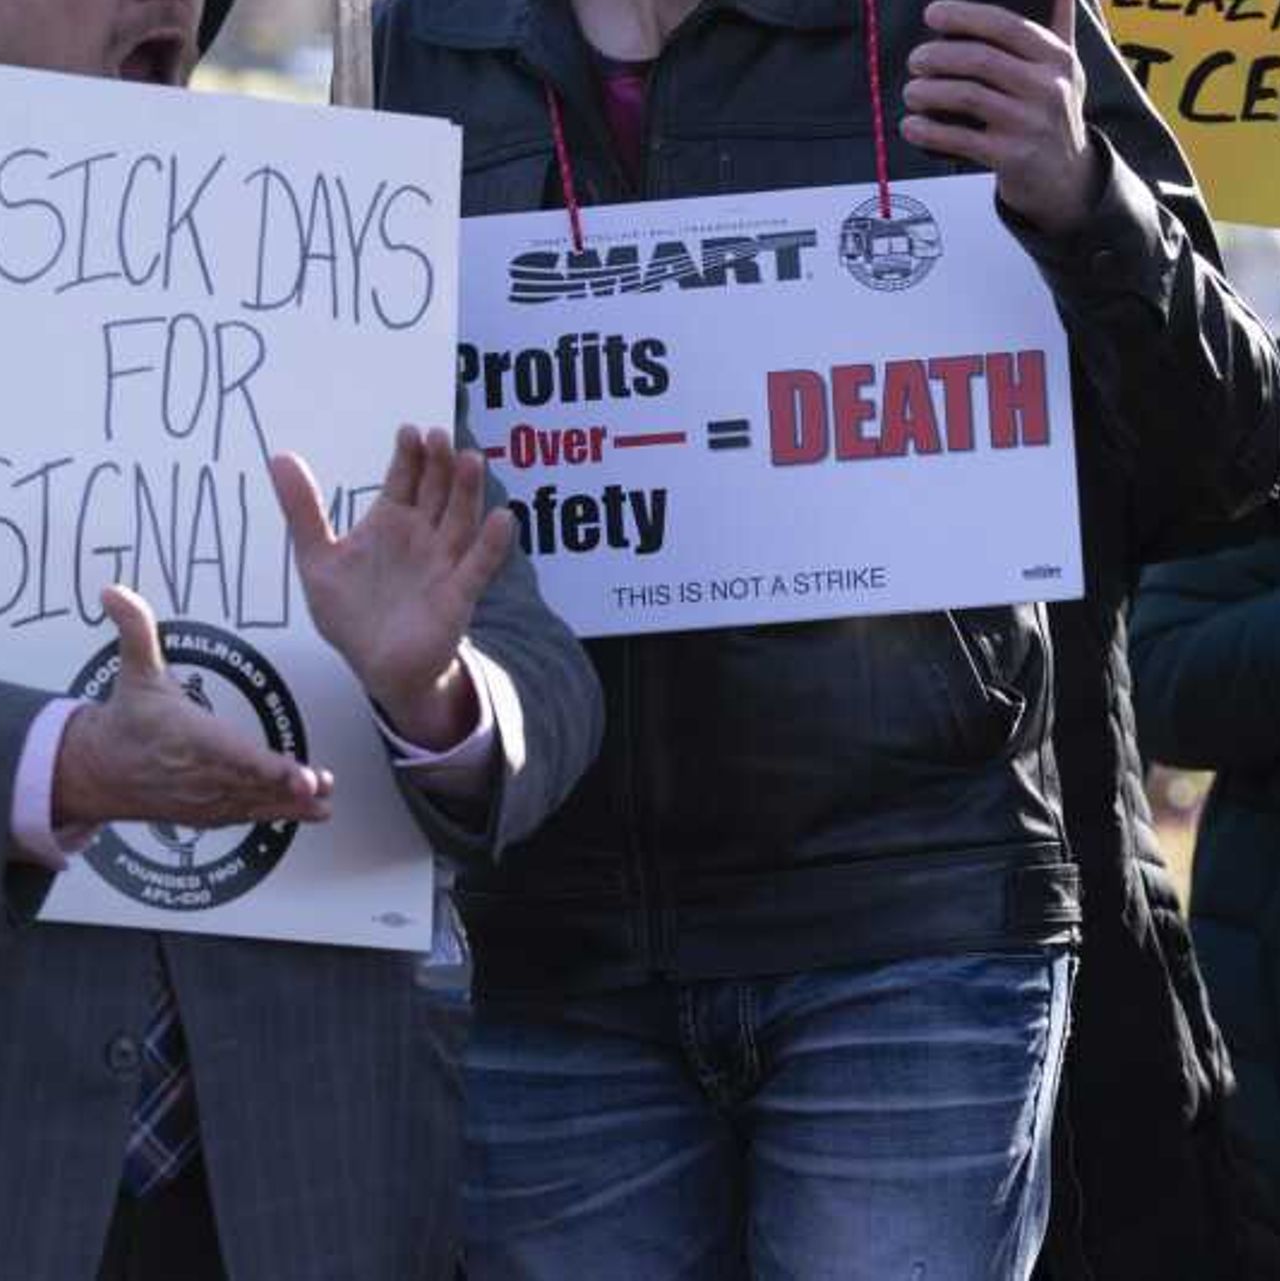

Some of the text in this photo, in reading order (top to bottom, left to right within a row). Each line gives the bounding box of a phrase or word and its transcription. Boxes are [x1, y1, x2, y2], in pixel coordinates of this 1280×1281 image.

[240, 166, 432, 329] DAYS
[508, 229, 816, 304] SMART
[102, 313, 272, 470] FOR
[457, 332, 670, 409] Profits
[767, 350, 1050, 467] DEATH
[508, 484, 667, 555] fety
[614, 567, 886, 608] THIS IS NOT A STRIKE
[166, 633, 265, 688] RAILROAD
[116, 855, 200, 888] FOUNDED
